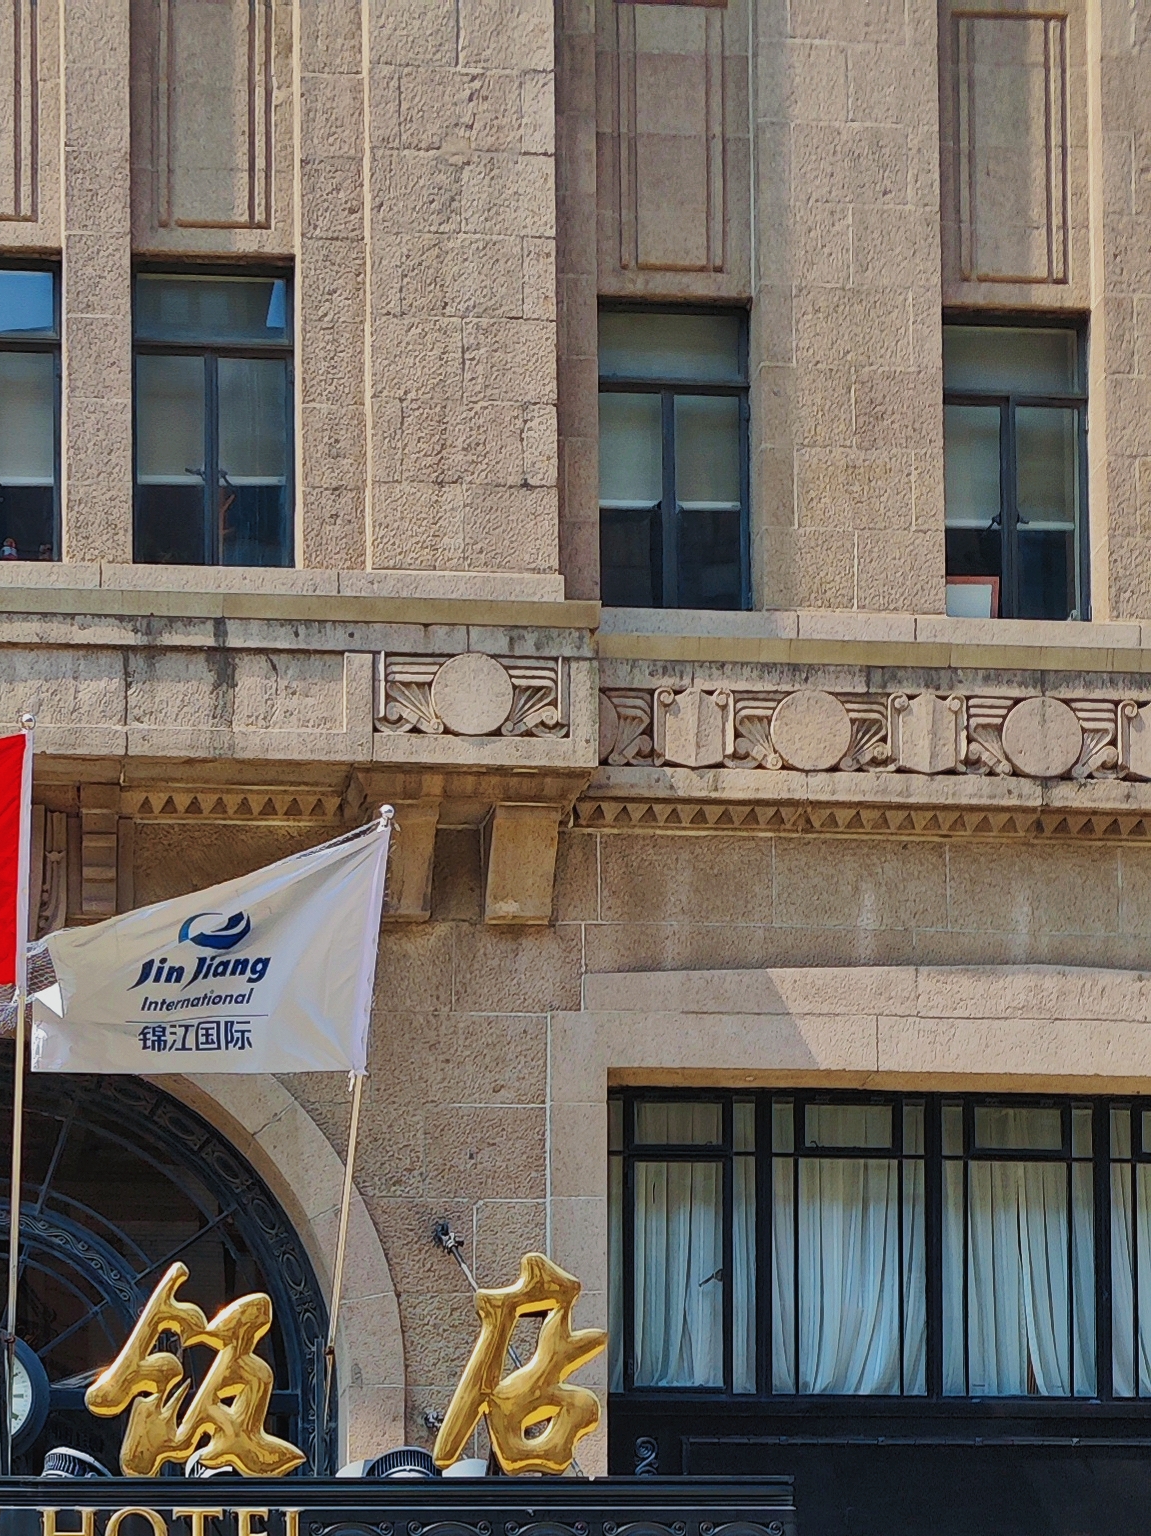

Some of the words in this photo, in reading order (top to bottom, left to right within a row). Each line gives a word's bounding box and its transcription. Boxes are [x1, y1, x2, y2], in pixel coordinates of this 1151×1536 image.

[126, 957, 185, 991] Jin
[180, 955, 272, 991] Jiang
[140, 988, 255, 1012] International
[138, 1020, 253, 1052] 锦江国际
